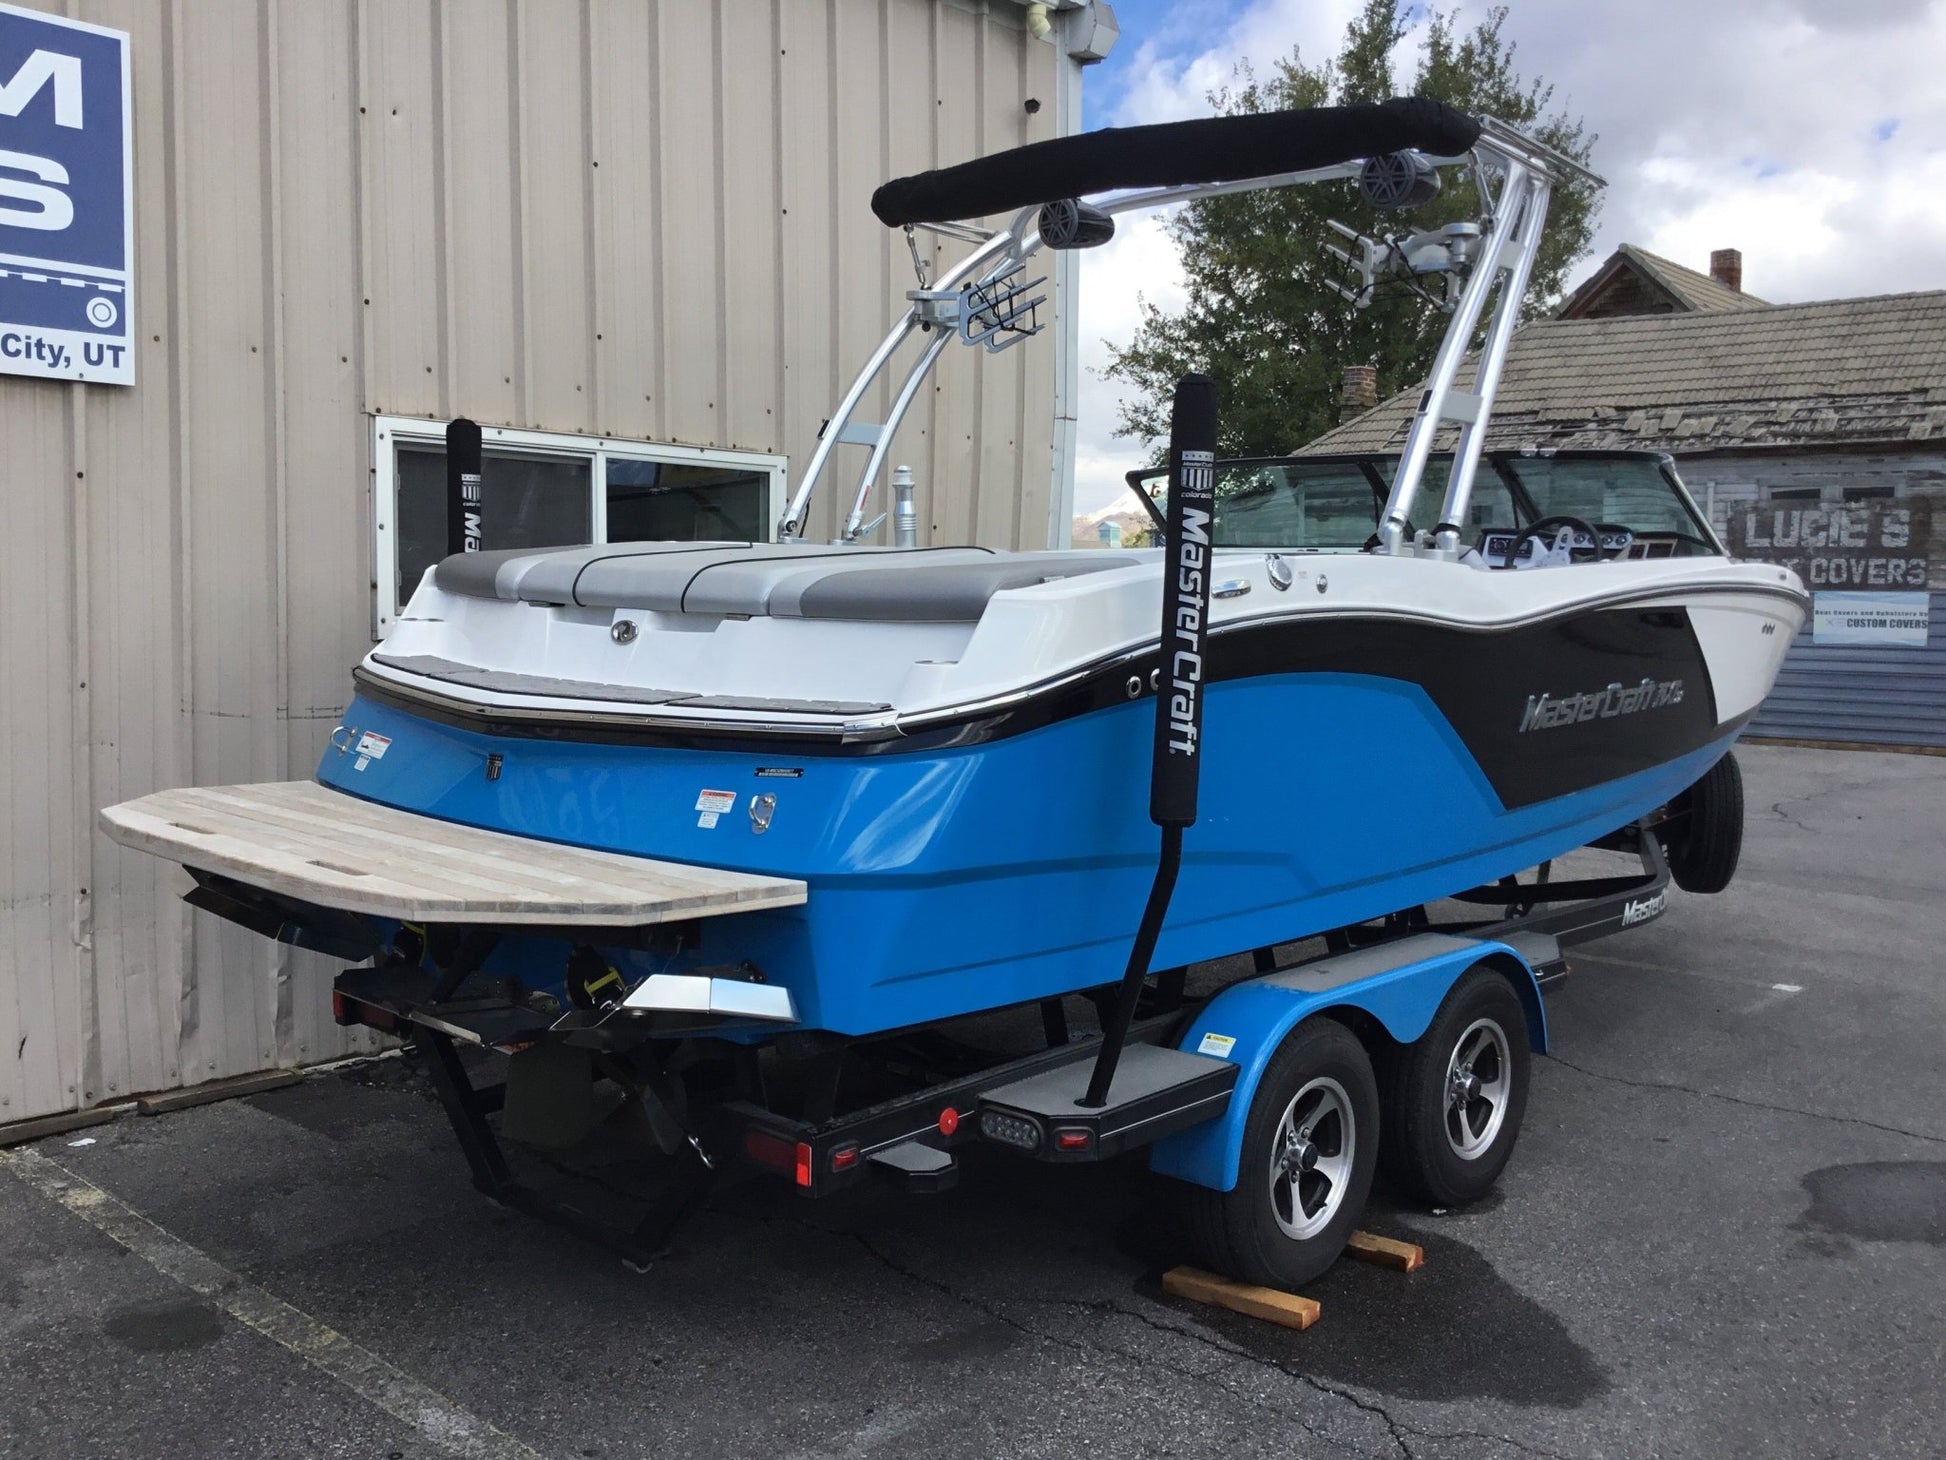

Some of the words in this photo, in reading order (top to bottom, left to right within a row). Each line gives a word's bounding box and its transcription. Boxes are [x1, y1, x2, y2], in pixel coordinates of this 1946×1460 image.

[0, 332, 72, 368] City,
[83, 341, 126, 369] UT
[1809, 558, 1927, 585] COVERS
[1846, 618, 1887, 629] CUSTOM
[1889, 618, 1928, 630] COVERS
[1519, 677, 1655, 733] MasterCraft
